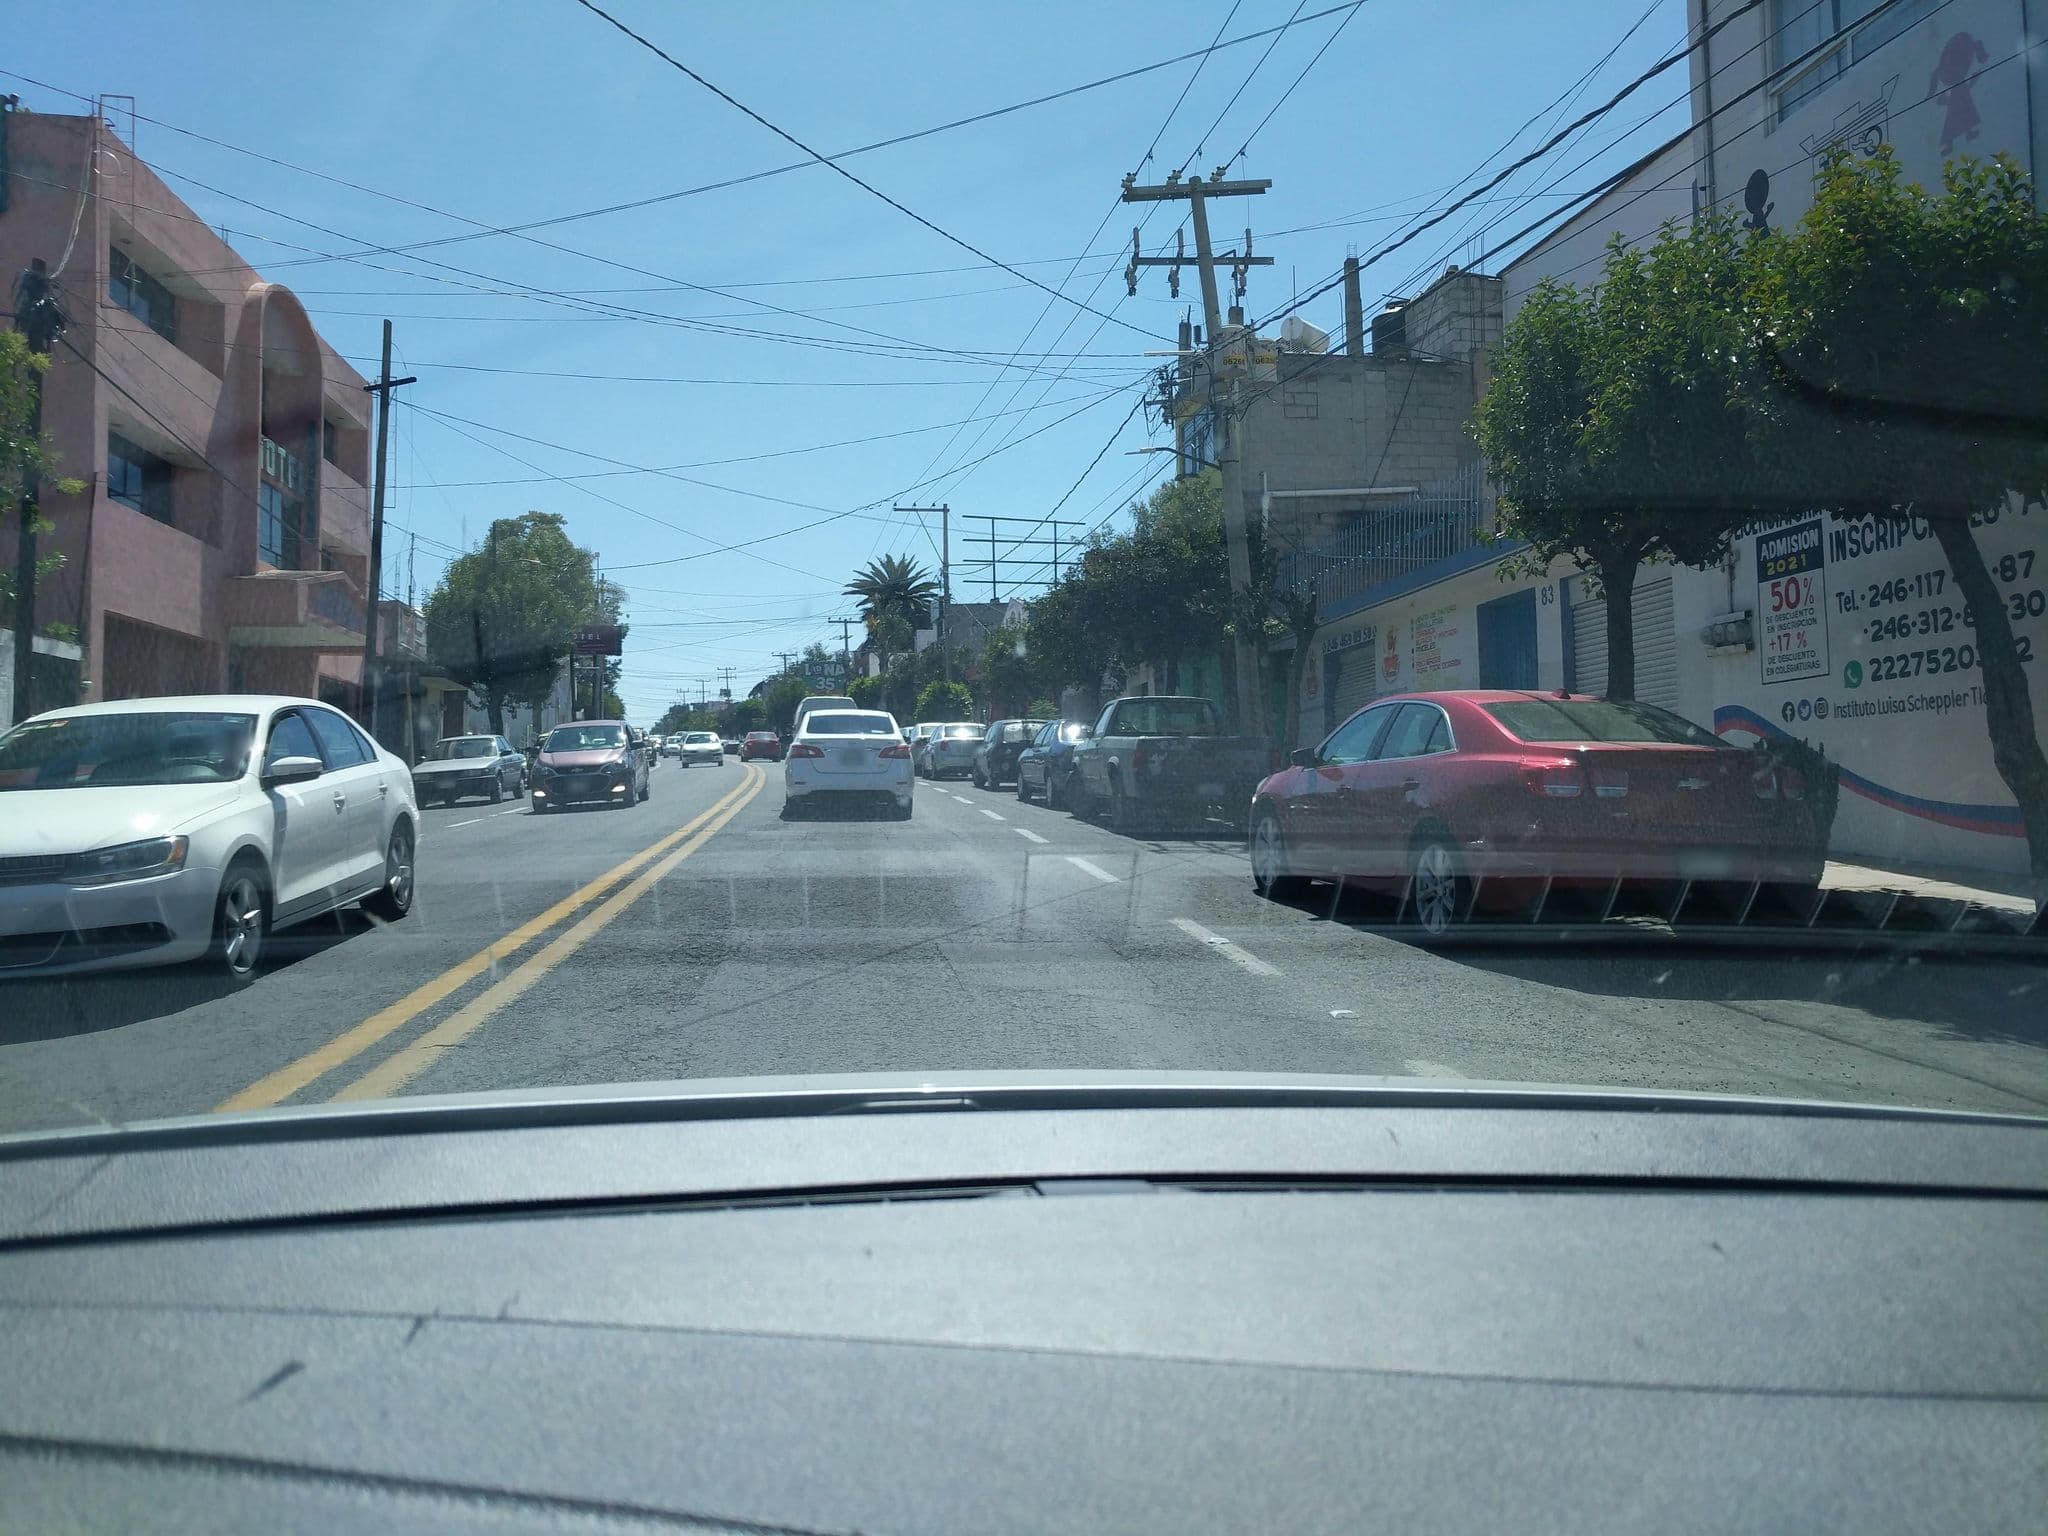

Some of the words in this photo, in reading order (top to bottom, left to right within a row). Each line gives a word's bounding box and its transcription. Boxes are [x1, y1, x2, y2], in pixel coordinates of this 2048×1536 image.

[1760, 526, 1819, 561] ADMISIÓN
[1766, 554, 1808, 577] 2021
[1541, 584, 1554, 606] 83
[1775, 607, 1815, 622] DESCUENTO
[1777, 650, 1817, 664] DESCUENTO
[1775, 659, 1821, 675] COLEGIATURAS
[816, 677, 835, 690] 35
[1833, 697, 1876, 719] Instituto
[1878, 696, 1906, 715] Luisa
[1907, 689, 1970, 715] Scheppler
